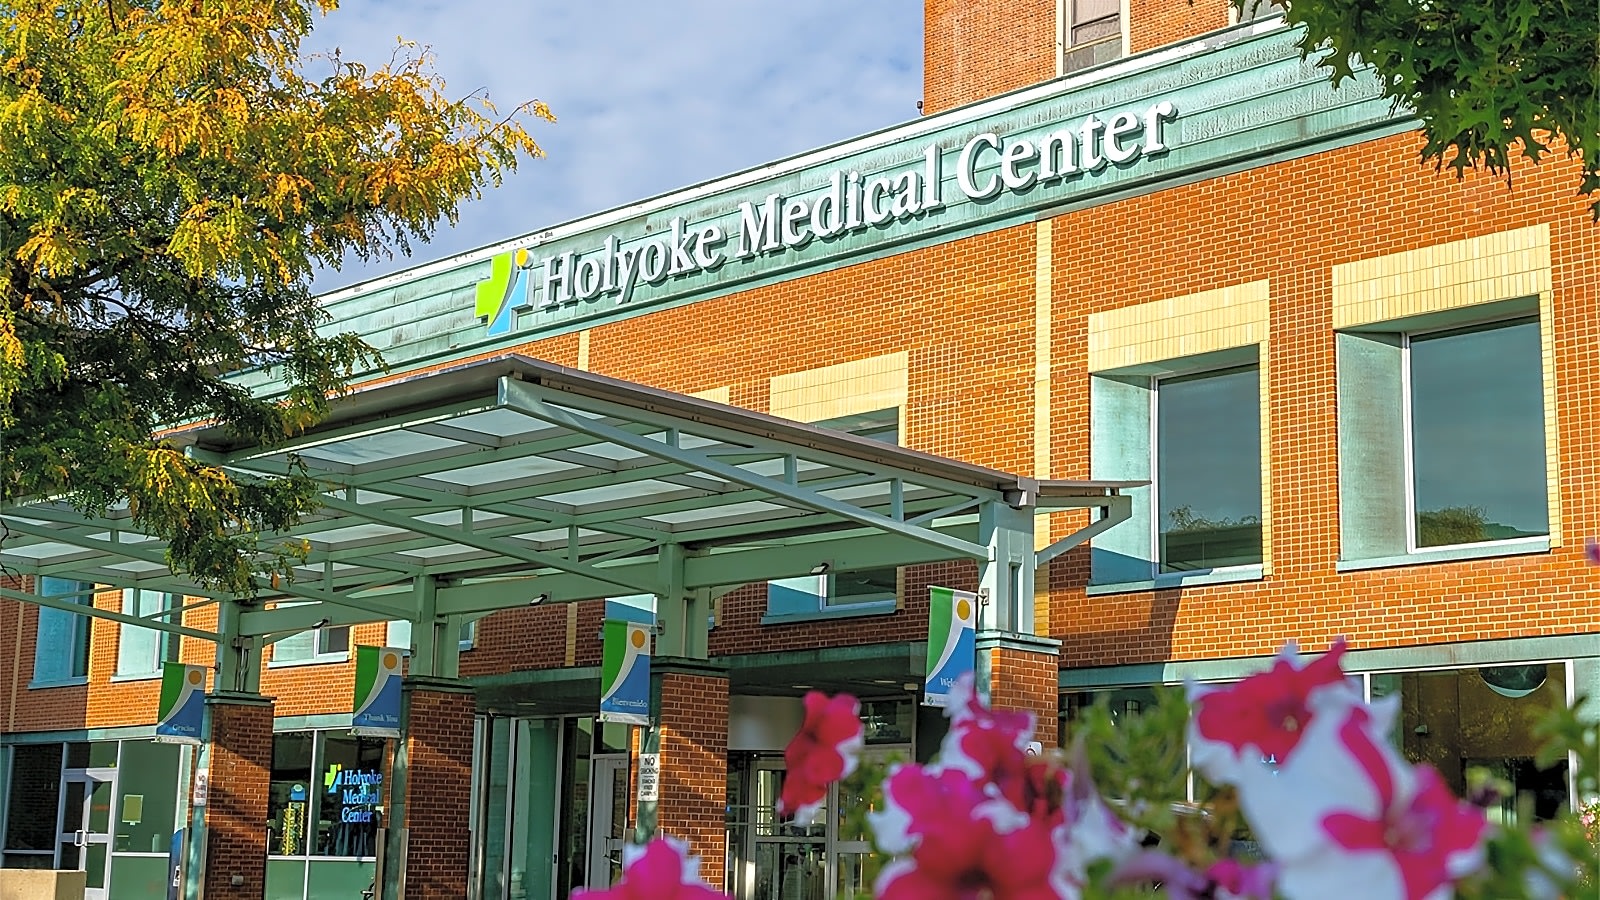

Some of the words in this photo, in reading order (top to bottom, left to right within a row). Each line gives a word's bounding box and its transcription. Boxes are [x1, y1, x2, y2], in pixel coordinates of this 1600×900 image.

[538, 216, 727, 307] Holyoke
[735, 143, 944, 259] Medical
[956, 100, 1177, 201] Center
[644, 756, 655, 767] NO
[343, 769, 383, 786] Holyoke
[342, 788, 380, 805] Medical
[341, 806, 373, 823] Center
